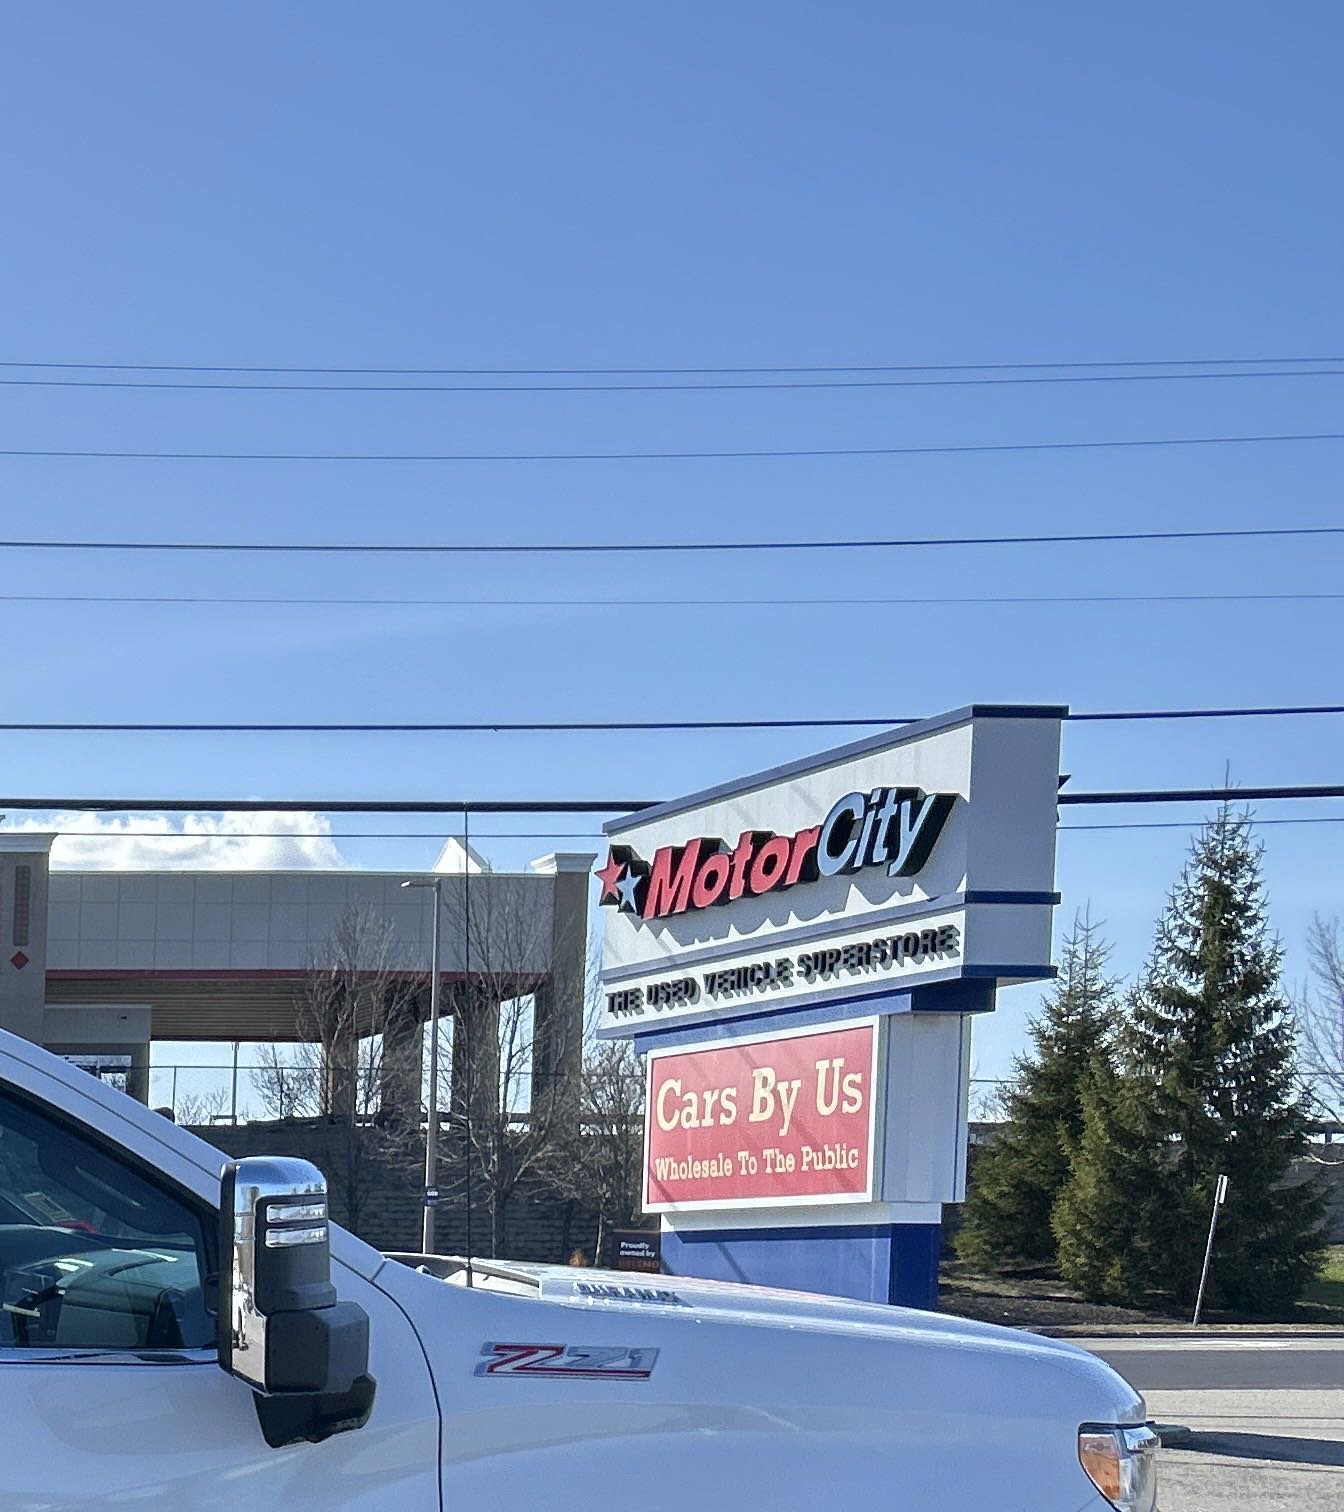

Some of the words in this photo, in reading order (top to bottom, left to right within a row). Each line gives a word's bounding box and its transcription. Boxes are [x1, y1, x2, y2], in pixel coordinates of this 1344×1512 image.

[643, 786, 942, 919] MotorCity
[605, 987, 645, 1018] THE
[647, 976, 700, 1010] USED
[703, 958, 795, 1001] VEHICLE
[797, 925, 961, 984] SUPERSTORE
[656, 1078, 737, 1131] Cars
[749, 1067, 801, 1136] By
[816, 1057, 863, 1116] Us
[655, 1153, 733, 1181] Wholesale
[738, 1151, 758, 1175] To
[763, 1147, 796, 1173] The
[801, 1143, 859, 1172] Public
[474, 1341, 661, 1382] Z71
